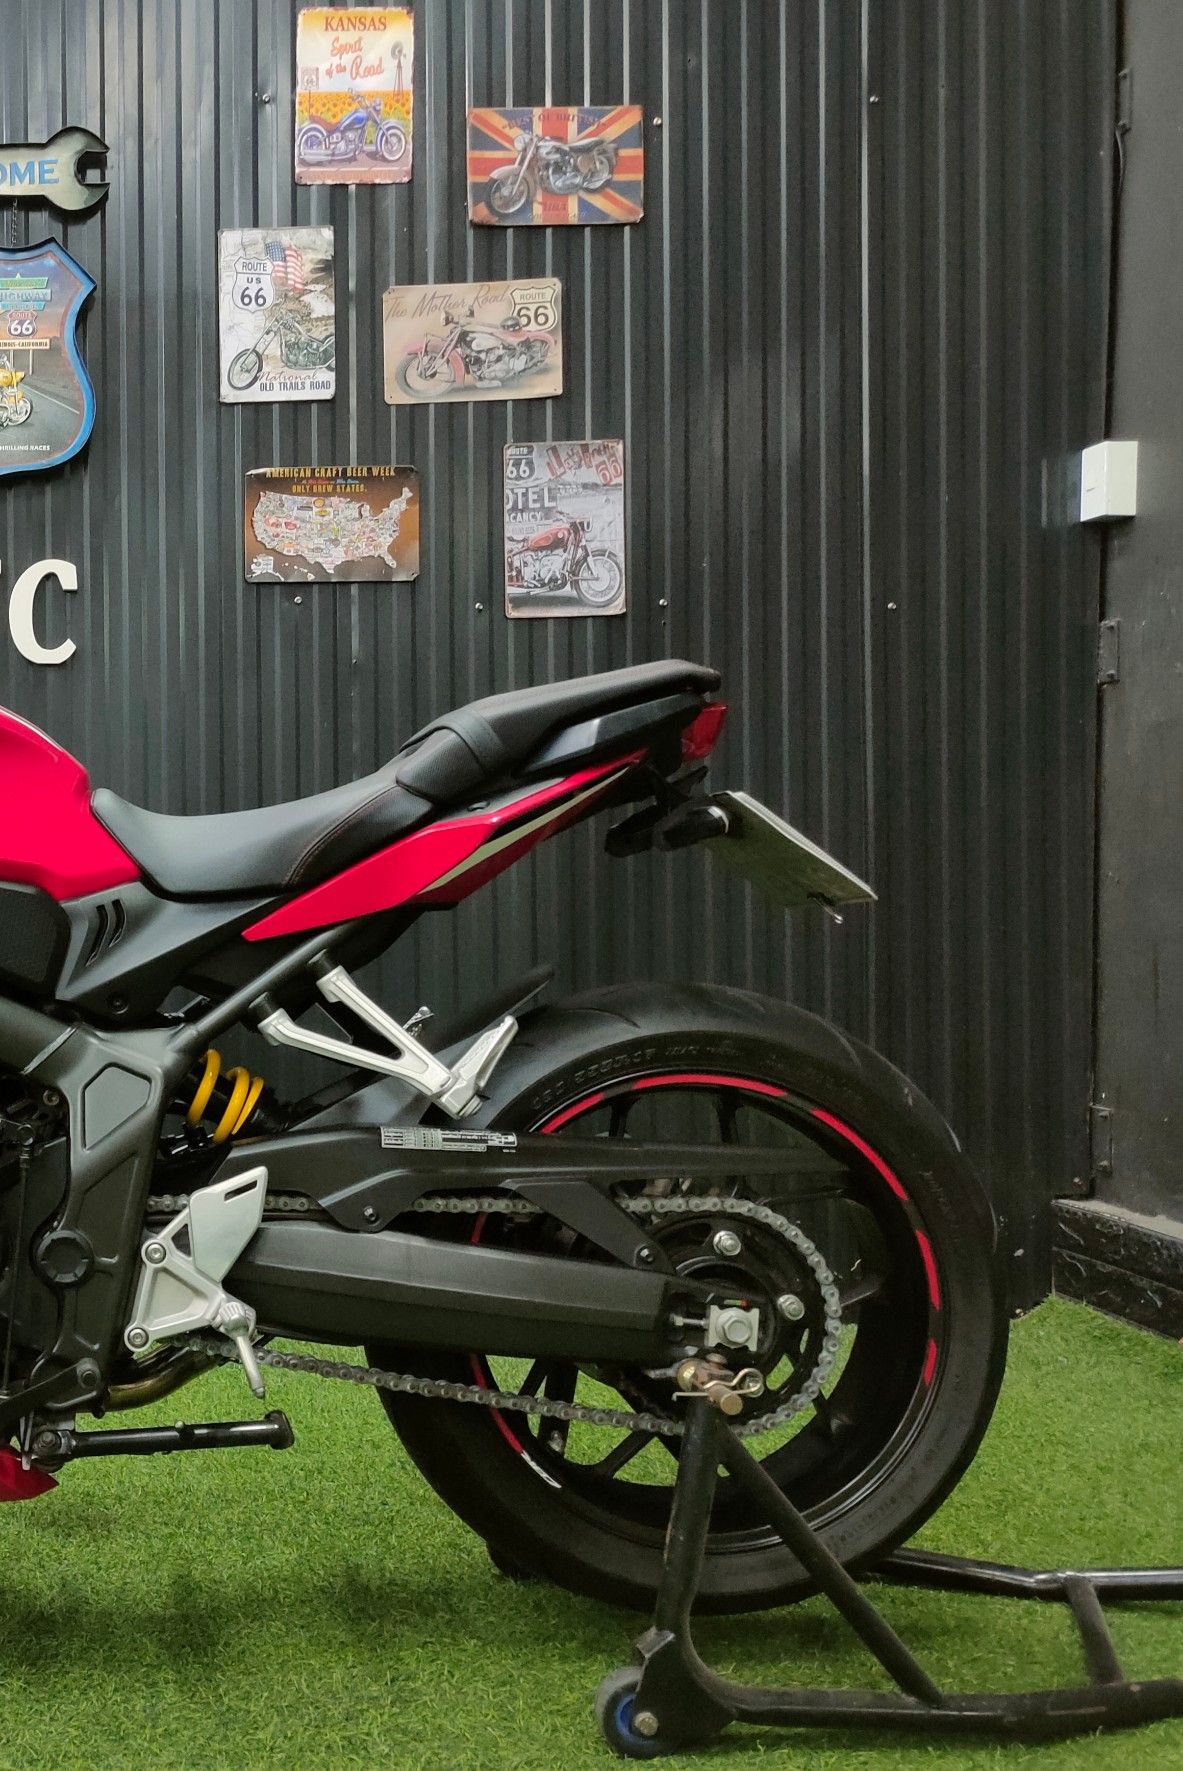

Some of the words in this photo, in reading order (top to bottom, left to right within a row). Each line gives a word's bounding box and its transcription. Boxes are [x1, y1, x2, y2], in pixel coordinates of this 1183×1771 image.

[324, 16, 387, 32] KANSAS
[330, 35, 364, 60] Spirit
[325, 63, 334, 79] of
[335, 61, 347, 74] the
[350, 55, 385, 80] Road
[241, 261, 268, 273] ROUTE
[246, 277, 262, 285] US
[240, 286, 267, 308] 66
[385, 295, 408, 323] The
[412, 290, 468, 322] Mother
[470, 284, 511, 310] Road
[519, 291, 547, 301] ROUTE
[516, 305, 550, 328] 66
[10, 319, 33, 336] 66
[257, 369, 319, 383] National
[259, 382, 275, 392] OLD
[278, 381, 306, 392] TRAILS
[309, 380, 332, 391] ROAD
[266, 467, 312, 478] AMERICAN
[314, 467, 343, 478] CRAFT
[346, 466, 368, 477] BEER
[371, 466, 396, 477] WEEK
[506, 459, 530, 479] 66
[292, 485, 310, 494] ONLY
[312, 484, 333, 493] BREW
